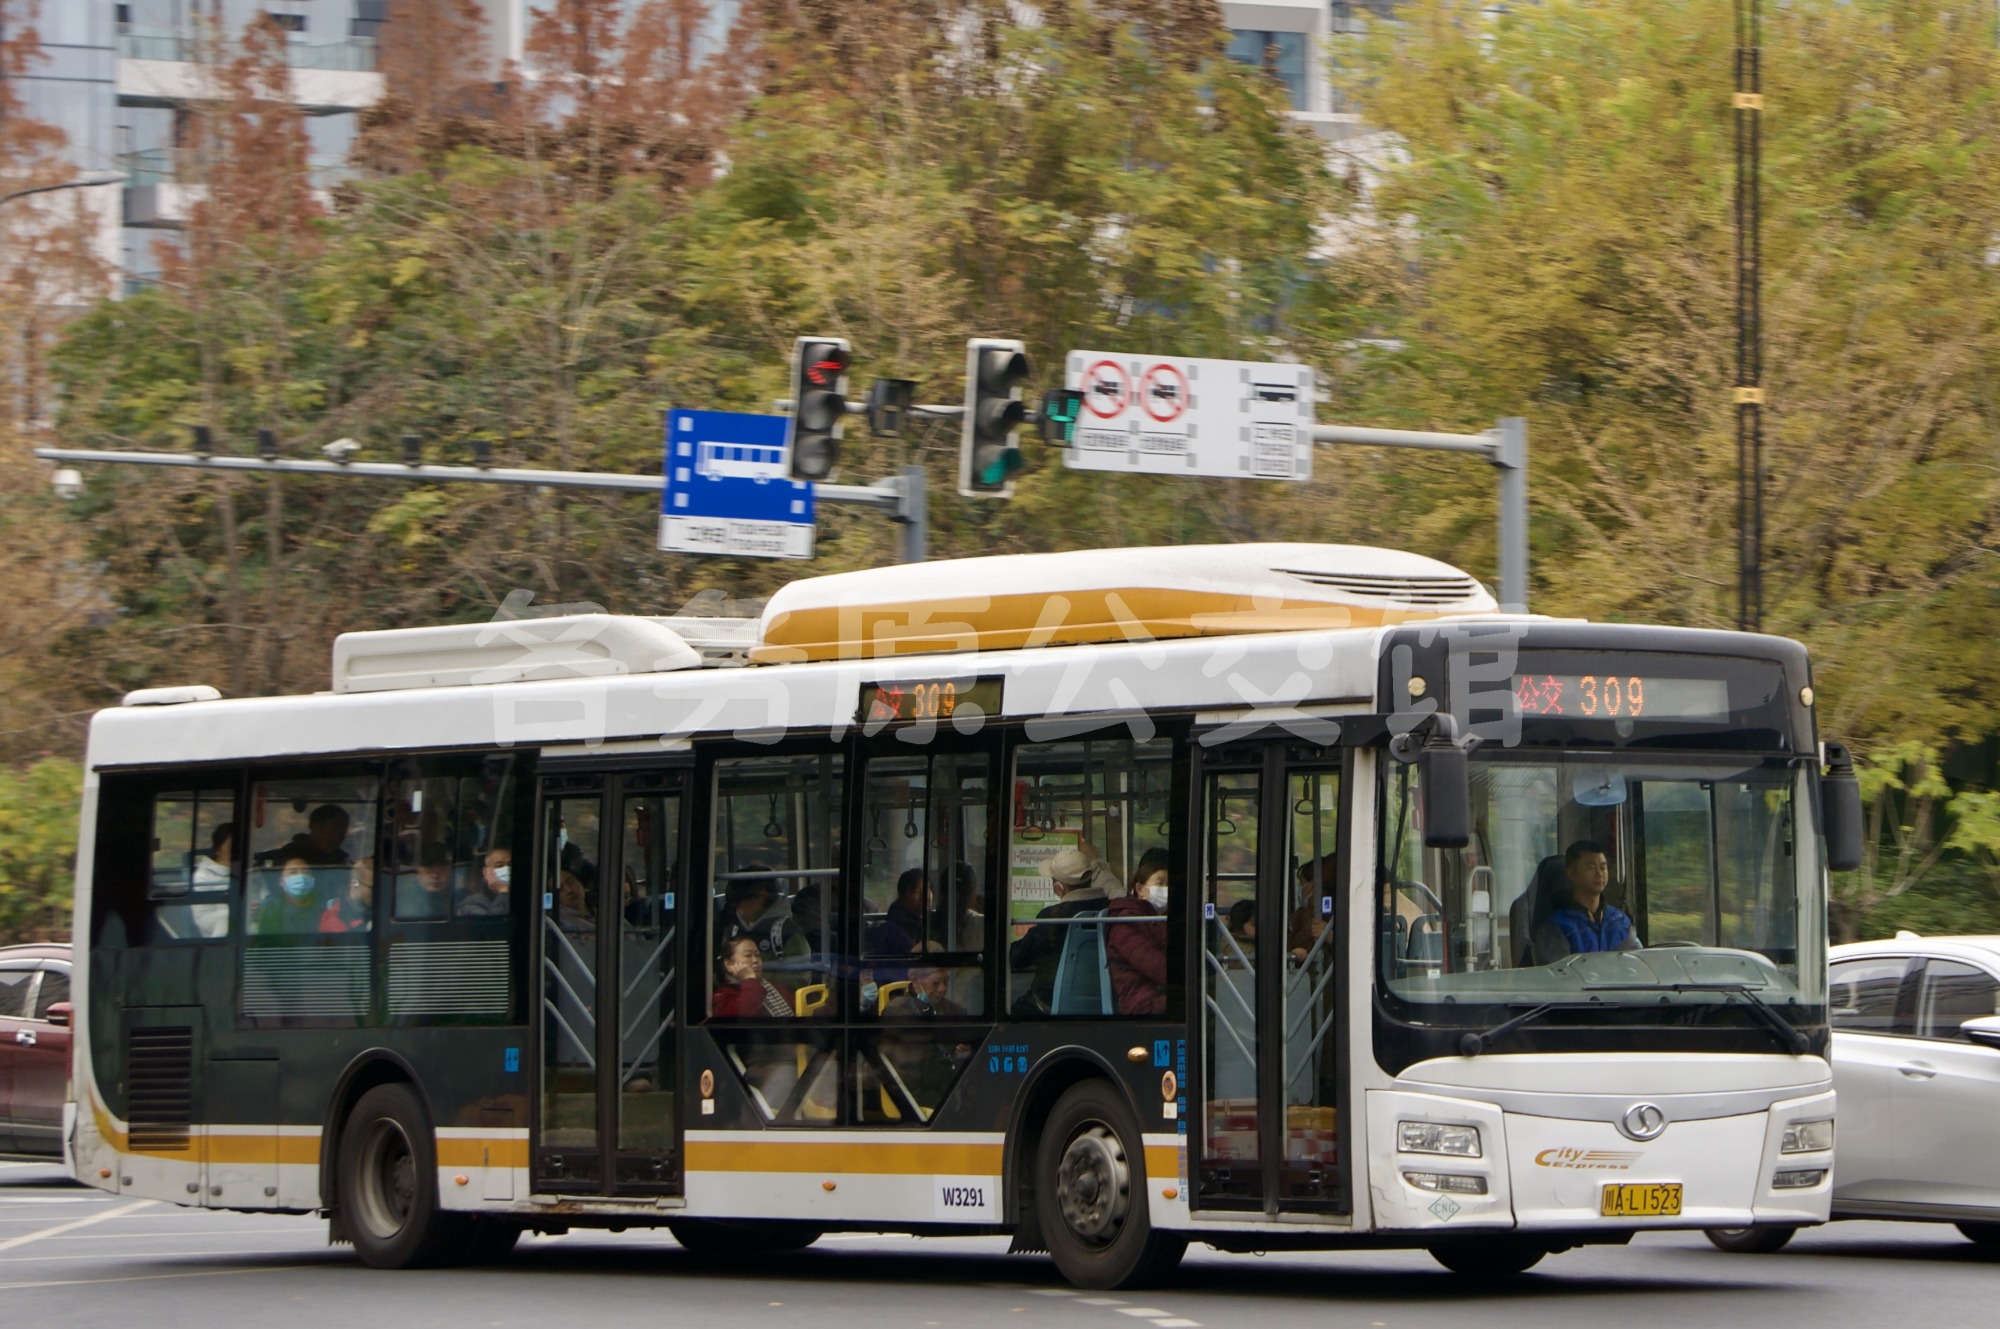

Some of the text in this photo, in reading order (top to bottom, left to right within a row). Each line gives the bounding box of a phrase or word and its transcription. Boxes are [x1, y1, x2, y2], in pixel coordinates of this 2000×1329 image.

[912, 681, 956, 717] 309
[1516, 674, 1645, 716] 公交 309
[1534, 1146, 1585, 1168] City
[1551, 1161, 1630, 1170] Express
[942, 1186, 985, 1208] W3291
[1434, 1202, 1455, 1214] CNG
